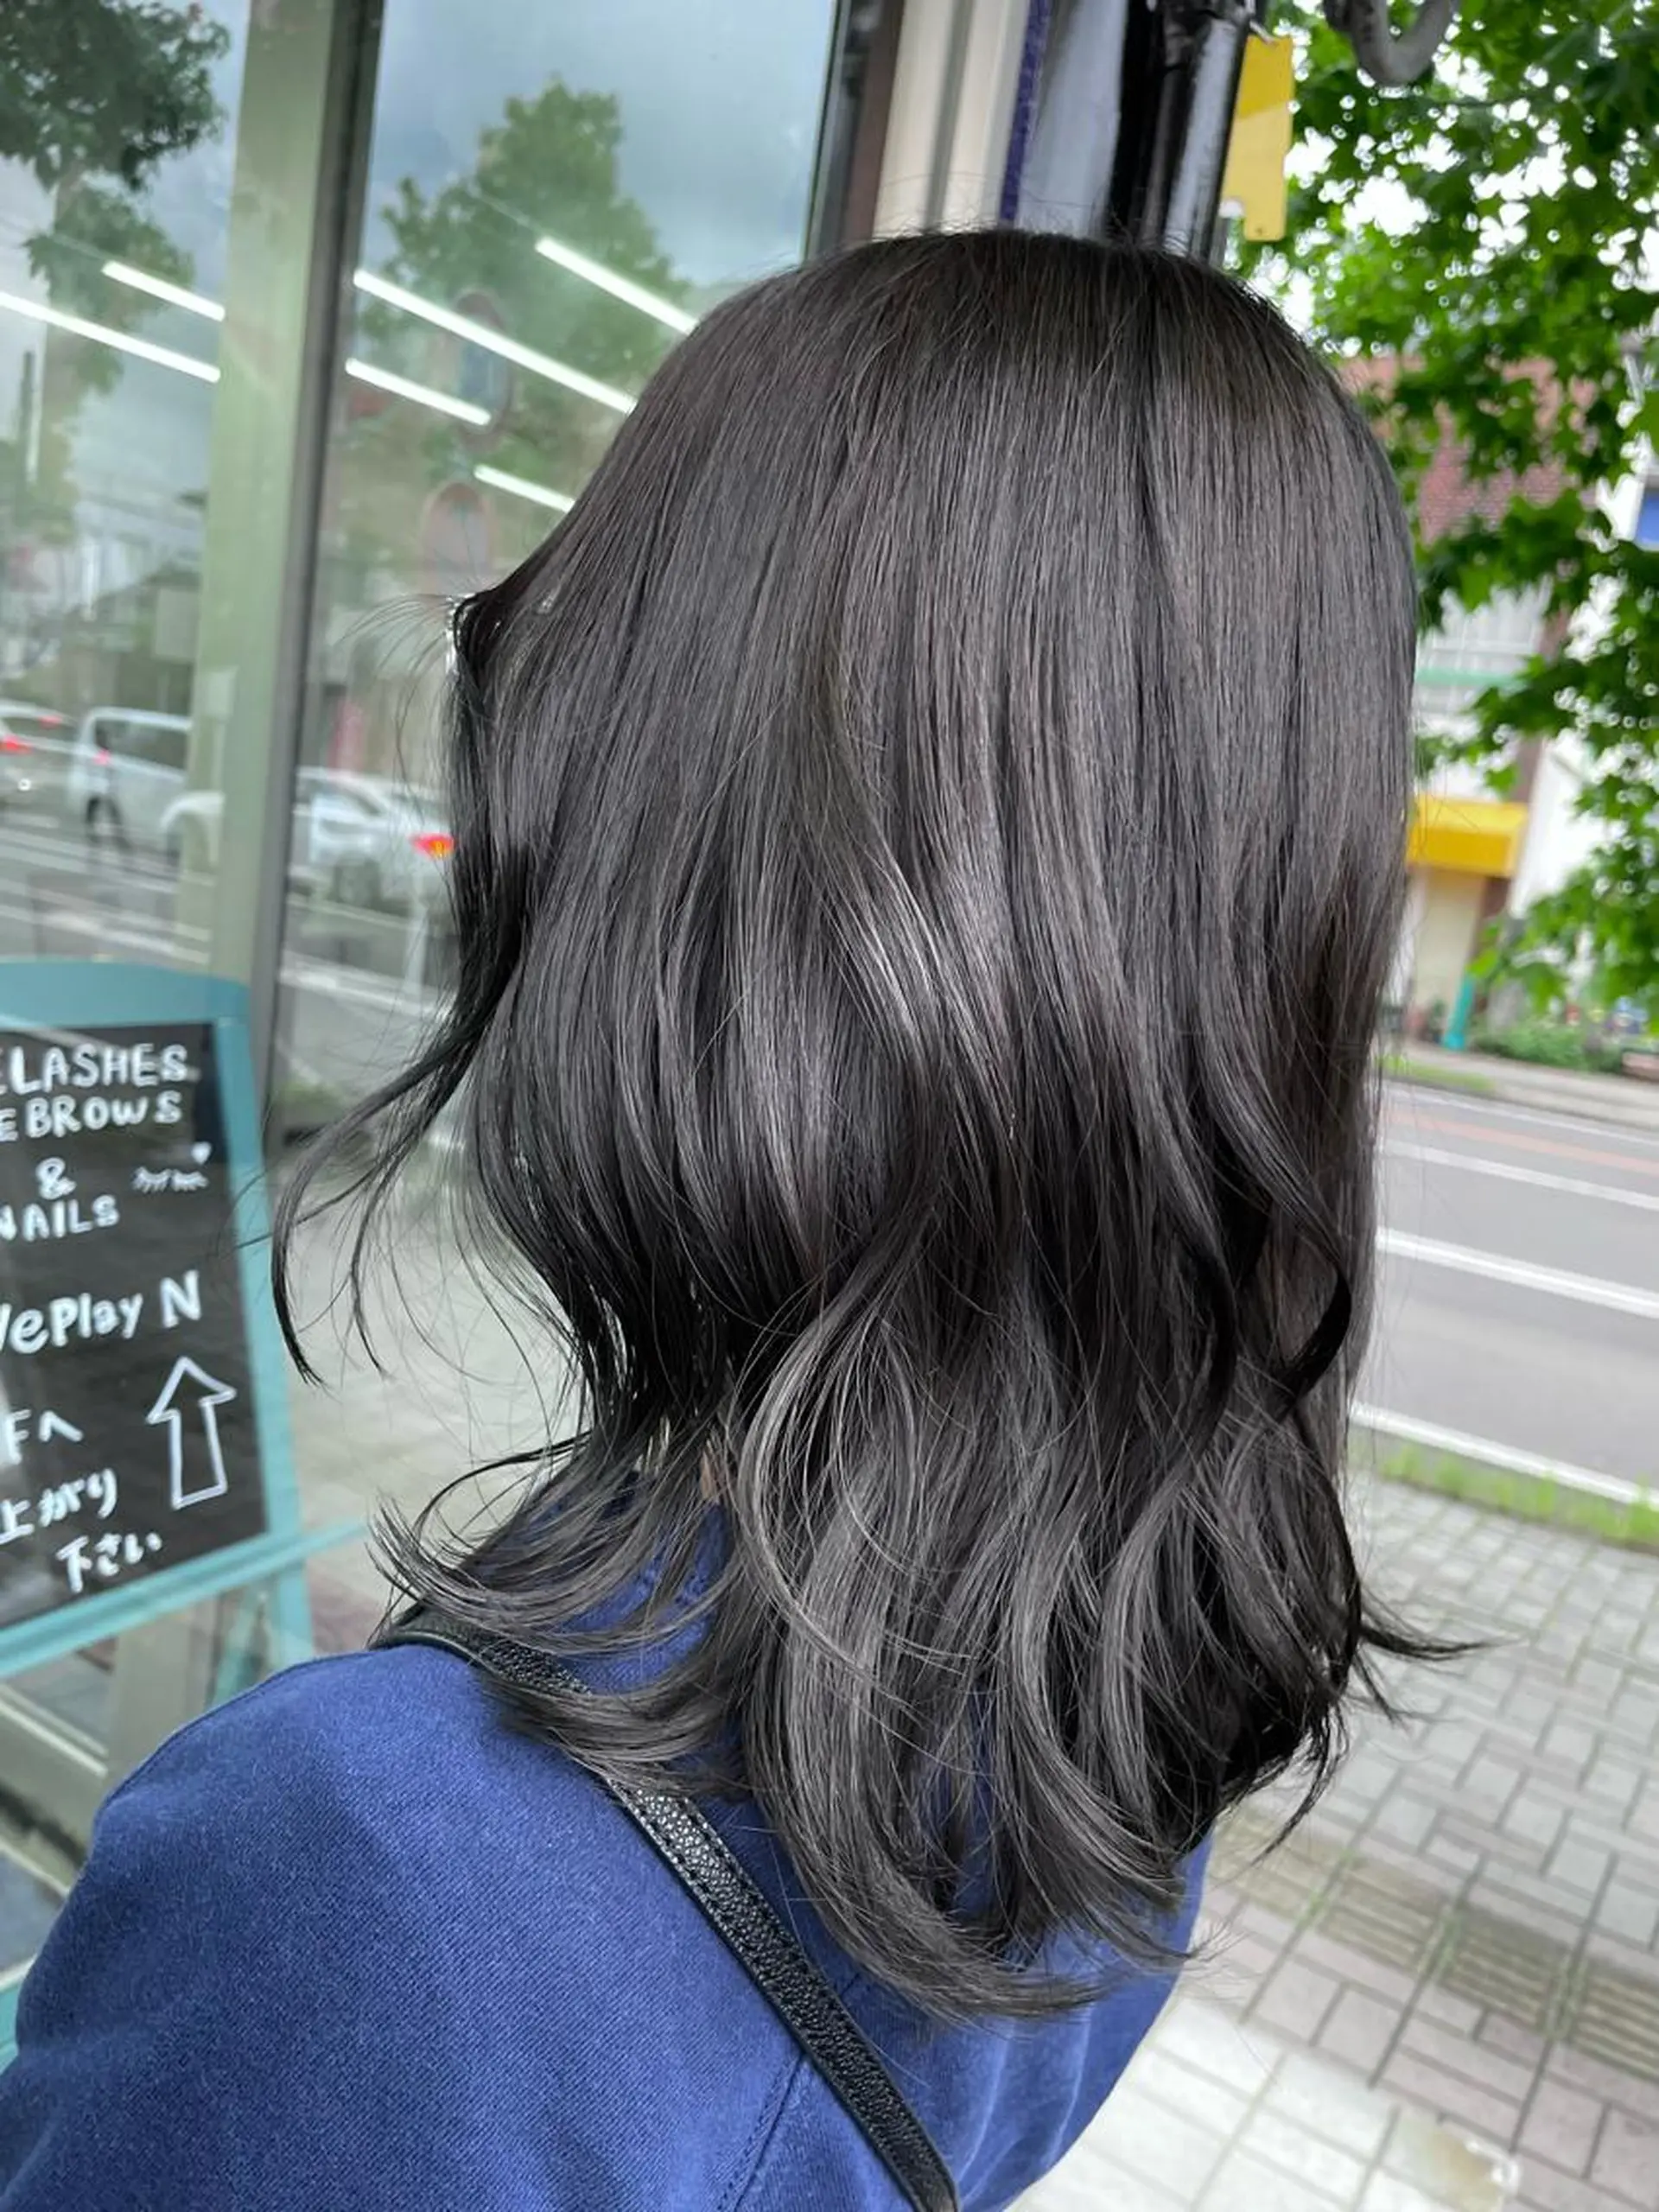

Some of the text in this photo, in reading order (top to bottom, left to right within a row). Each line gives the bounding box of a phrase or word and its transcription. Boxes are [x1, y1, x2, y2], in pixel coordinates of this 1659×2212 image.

[0, 1043, 187, 1094] LASHES
[35, 1157, 76, 1200] &
[160, 1269, 201, 1328] N
[55, 1532, 162, 1593] 下さい
